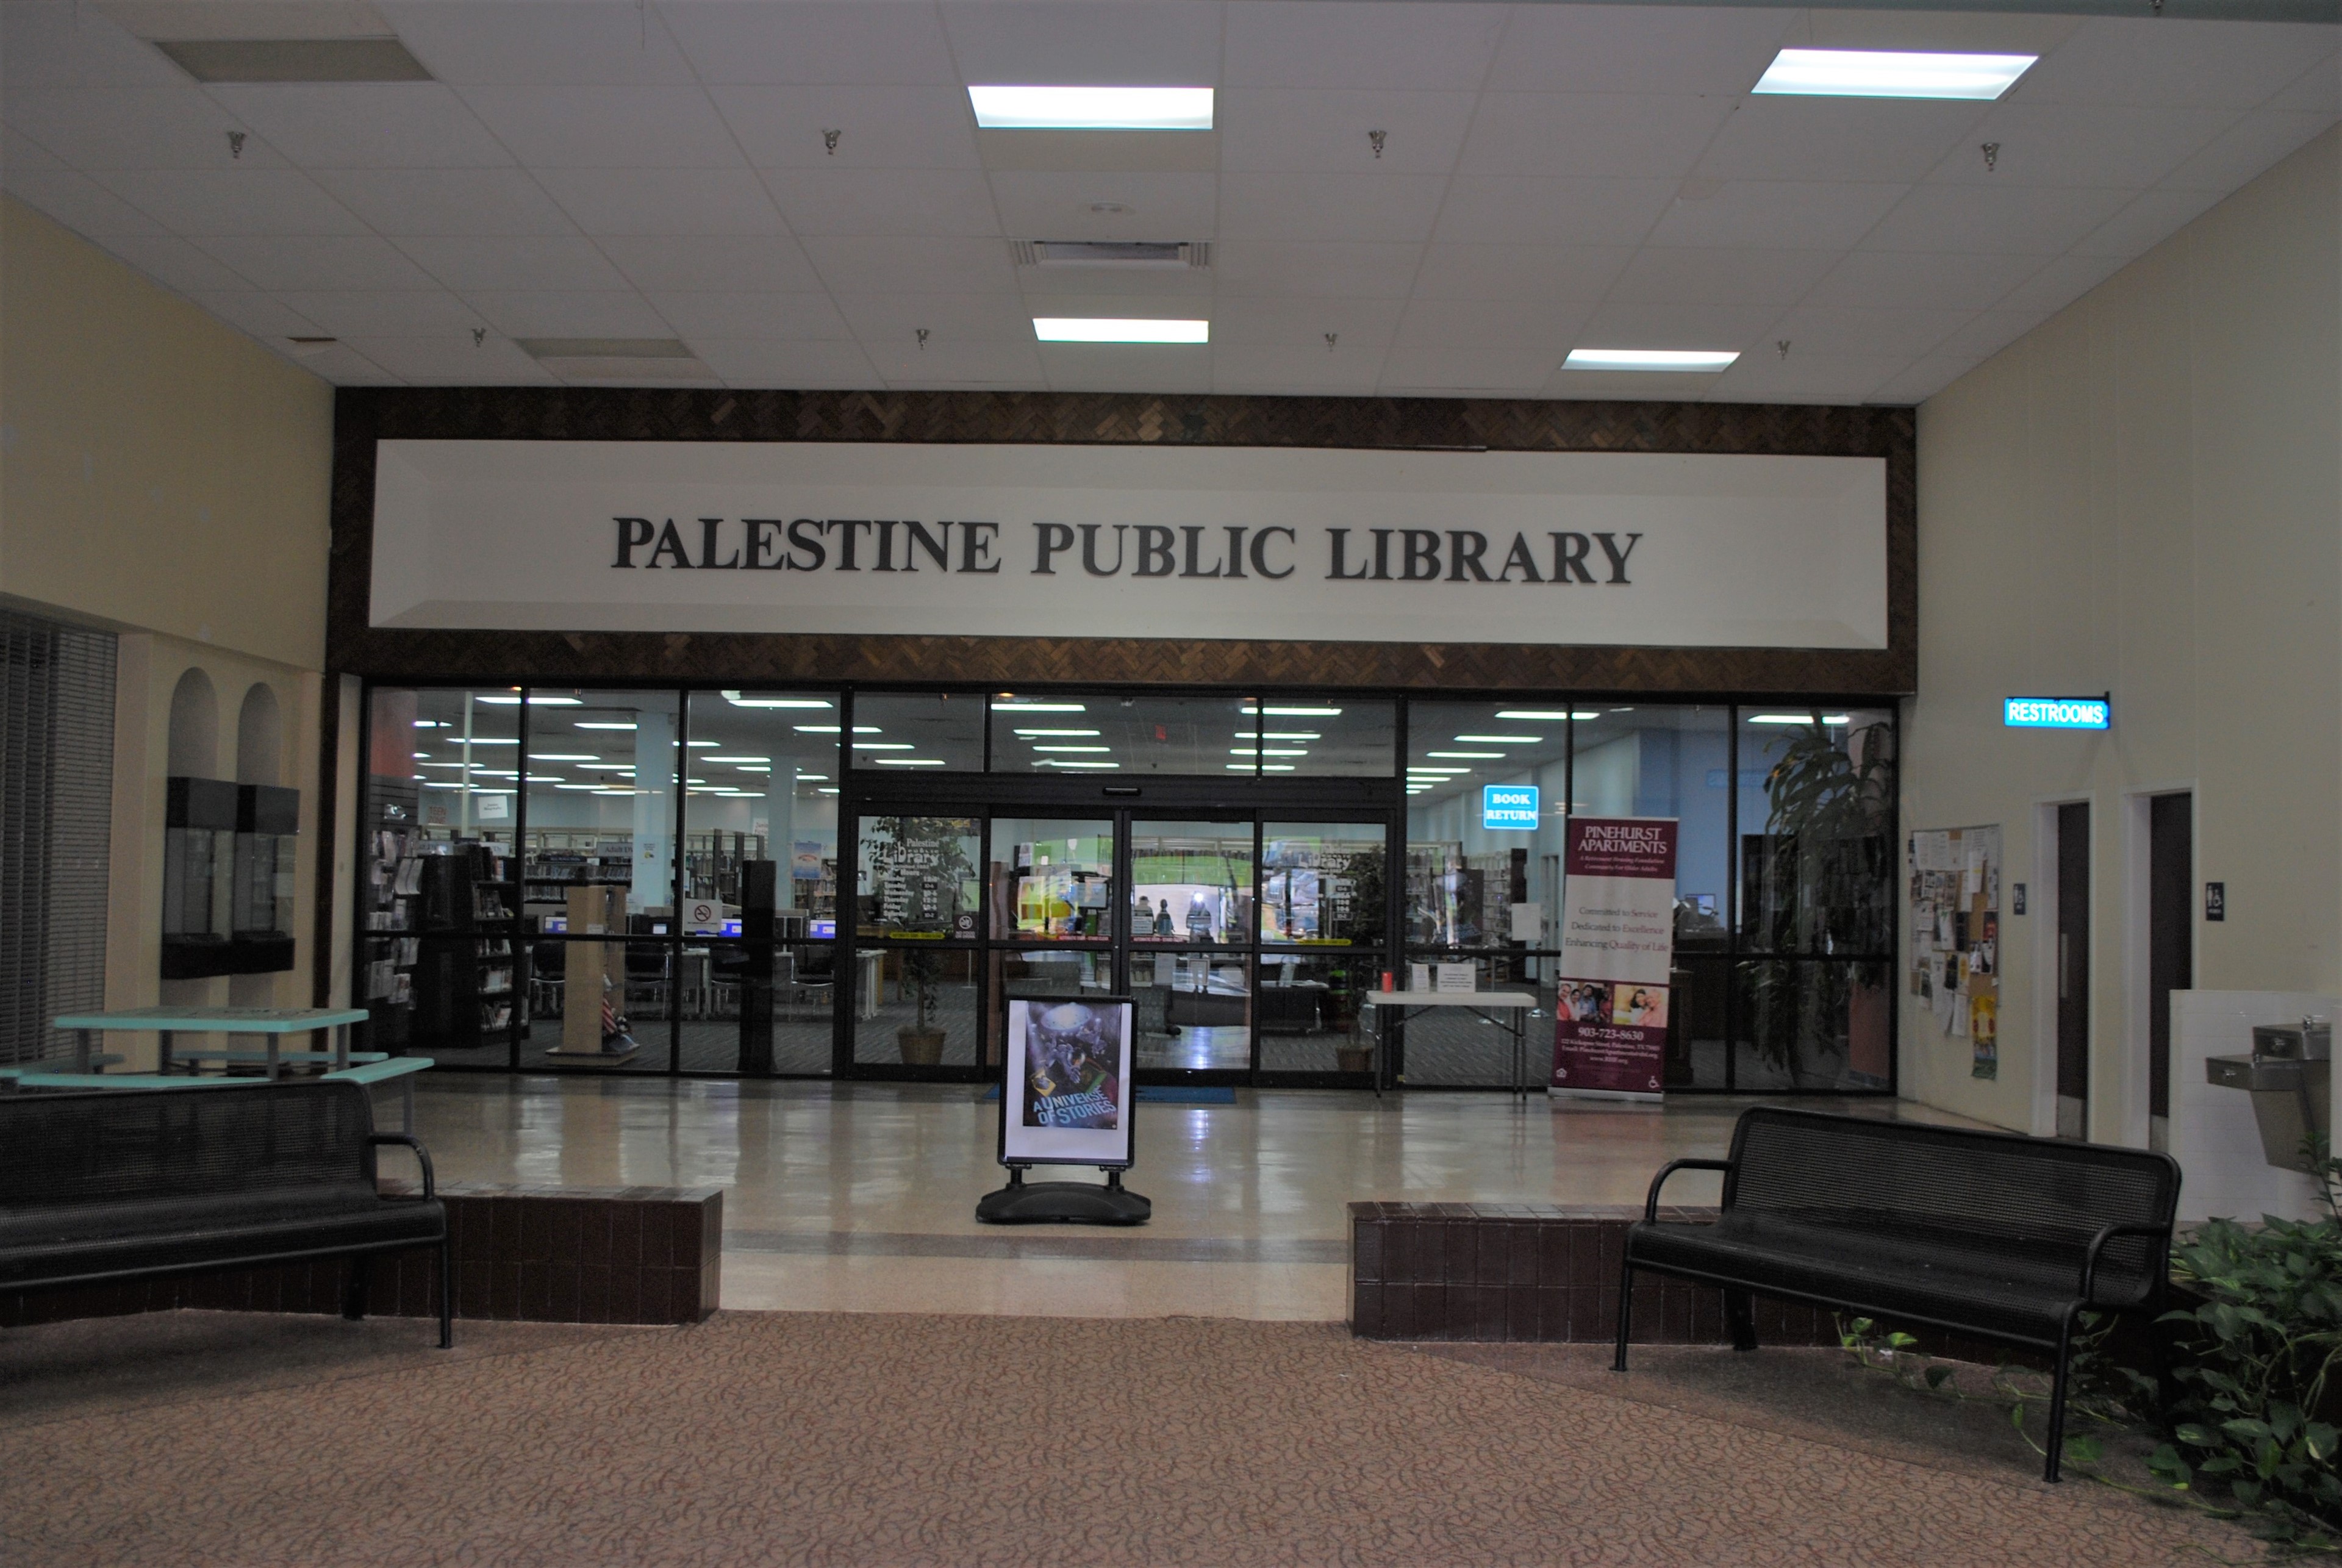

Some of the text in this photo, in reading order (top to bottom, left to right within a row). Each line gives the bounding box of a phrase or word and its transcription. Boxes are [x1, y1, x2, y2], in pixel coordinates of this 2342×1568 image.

[610, 516, 1643, 584] PALESTINE PUBLIC LIBRARY
[2008, 702, 2104, 724] RESTROOMS
[1492, 793, 1531, 805] BOOK
[1486, 809, 1537, 821] RETURN
[1585, 826, 1662, 840] PINEHURST
[906, 838, 939, 848] Palestine
[1578, 839, 1668, 854] APARTMENTS
[883, 841, 940, 867] Library
[1578, 906, 1620, 916] Committed
[1631, 909, 1659, 918] Service
[1571, 921, 1611, 931] Dedicated
[1622, 924, 1664, 934] Excellence
[1565, 937, 1669, 952] Enhancing Quality of Life
[1578, 1026, 1644, 1042] 903-723-8630
[1034, 1087, 1108, 1112] A UNIVERSE
[1038, 1100, 1117, 1124] OF STORIES
